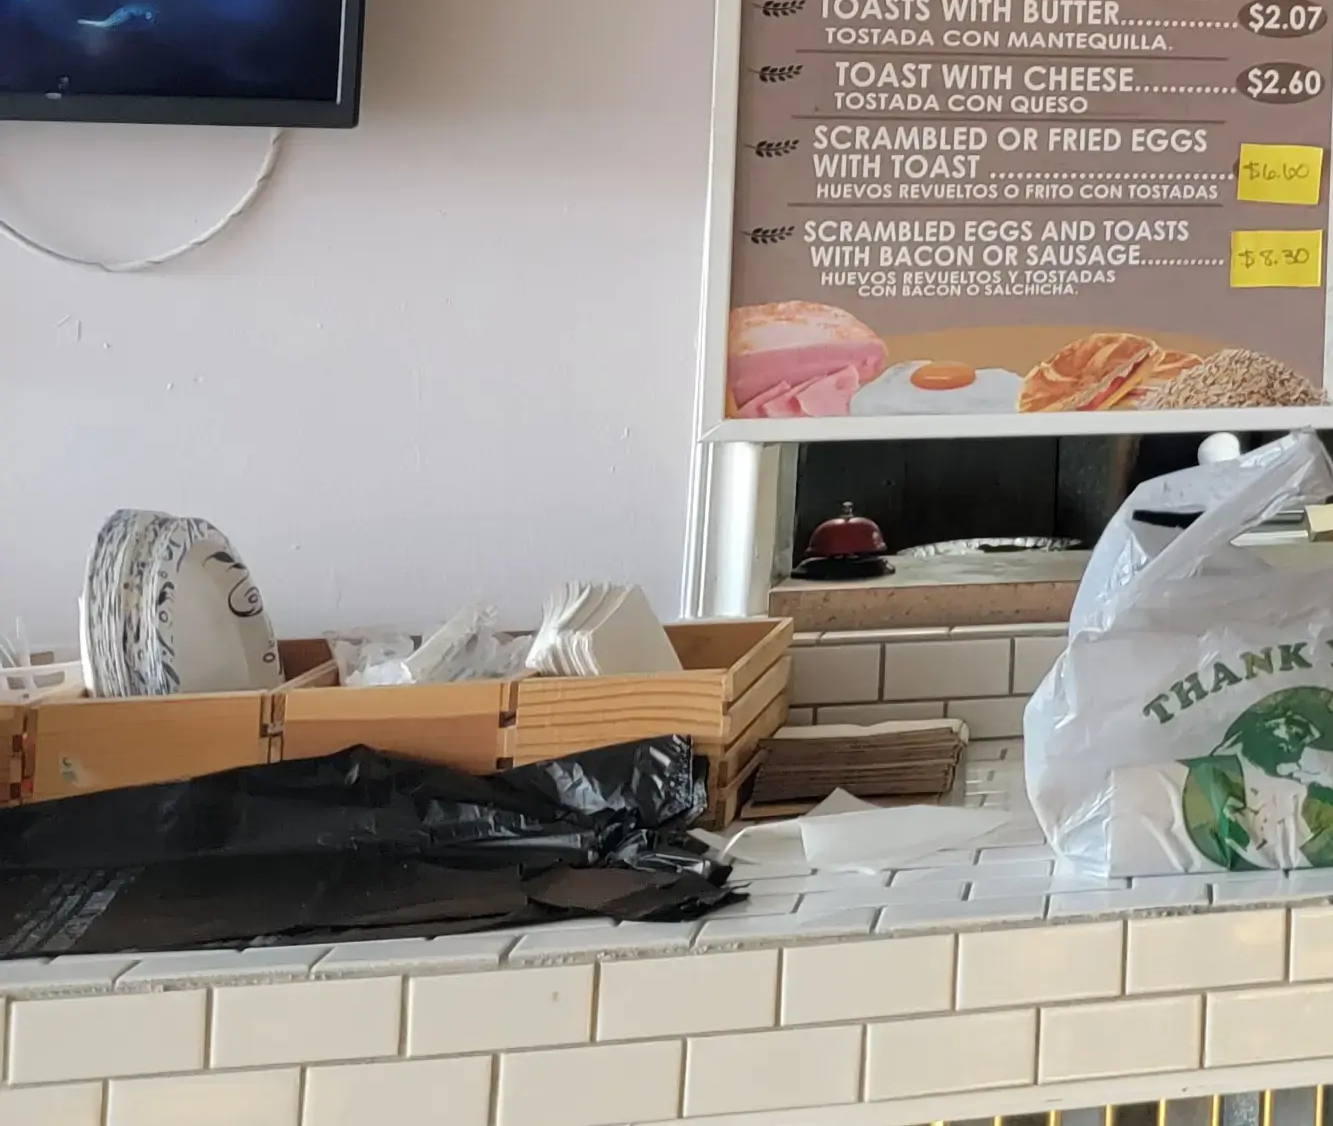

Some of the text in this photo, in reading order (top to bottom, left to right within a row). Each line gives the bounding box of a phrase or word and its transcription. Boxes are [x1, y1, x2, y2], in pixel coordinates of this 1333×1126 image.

[1249, 3, 1323, 33] $2.07
[825, 27, 999, 47] TOSTADA CON
[835, 62, 1321, 98] TOAST WITH $2.60
[834, 92, 1088, 113] TOSTADA CON QUESO
[813, 125, 1207, 152] SCRAMBLED OR FRIED EGGS
[813, 154, 980, 179] WITH TOAST
[1243, 161, 1309, 181] $6.60
[817, 183, 1218, 199] HUEVOS REVUELTOS FRITO CON TOSTADAS
[804, 220, 1189, 242] SCRAMBLED EGGS AND TOASTS
[811, 245, 1018, 267] WITH BACON OR
[1238, 248, 1310, 268] $8.30
[821, 270, 1115, 285] HUEVOS REVUELTOS TOSTADAS
[858, 284, 961, 297] CON BACON
[1143, 642, 1313, 725] THANK
